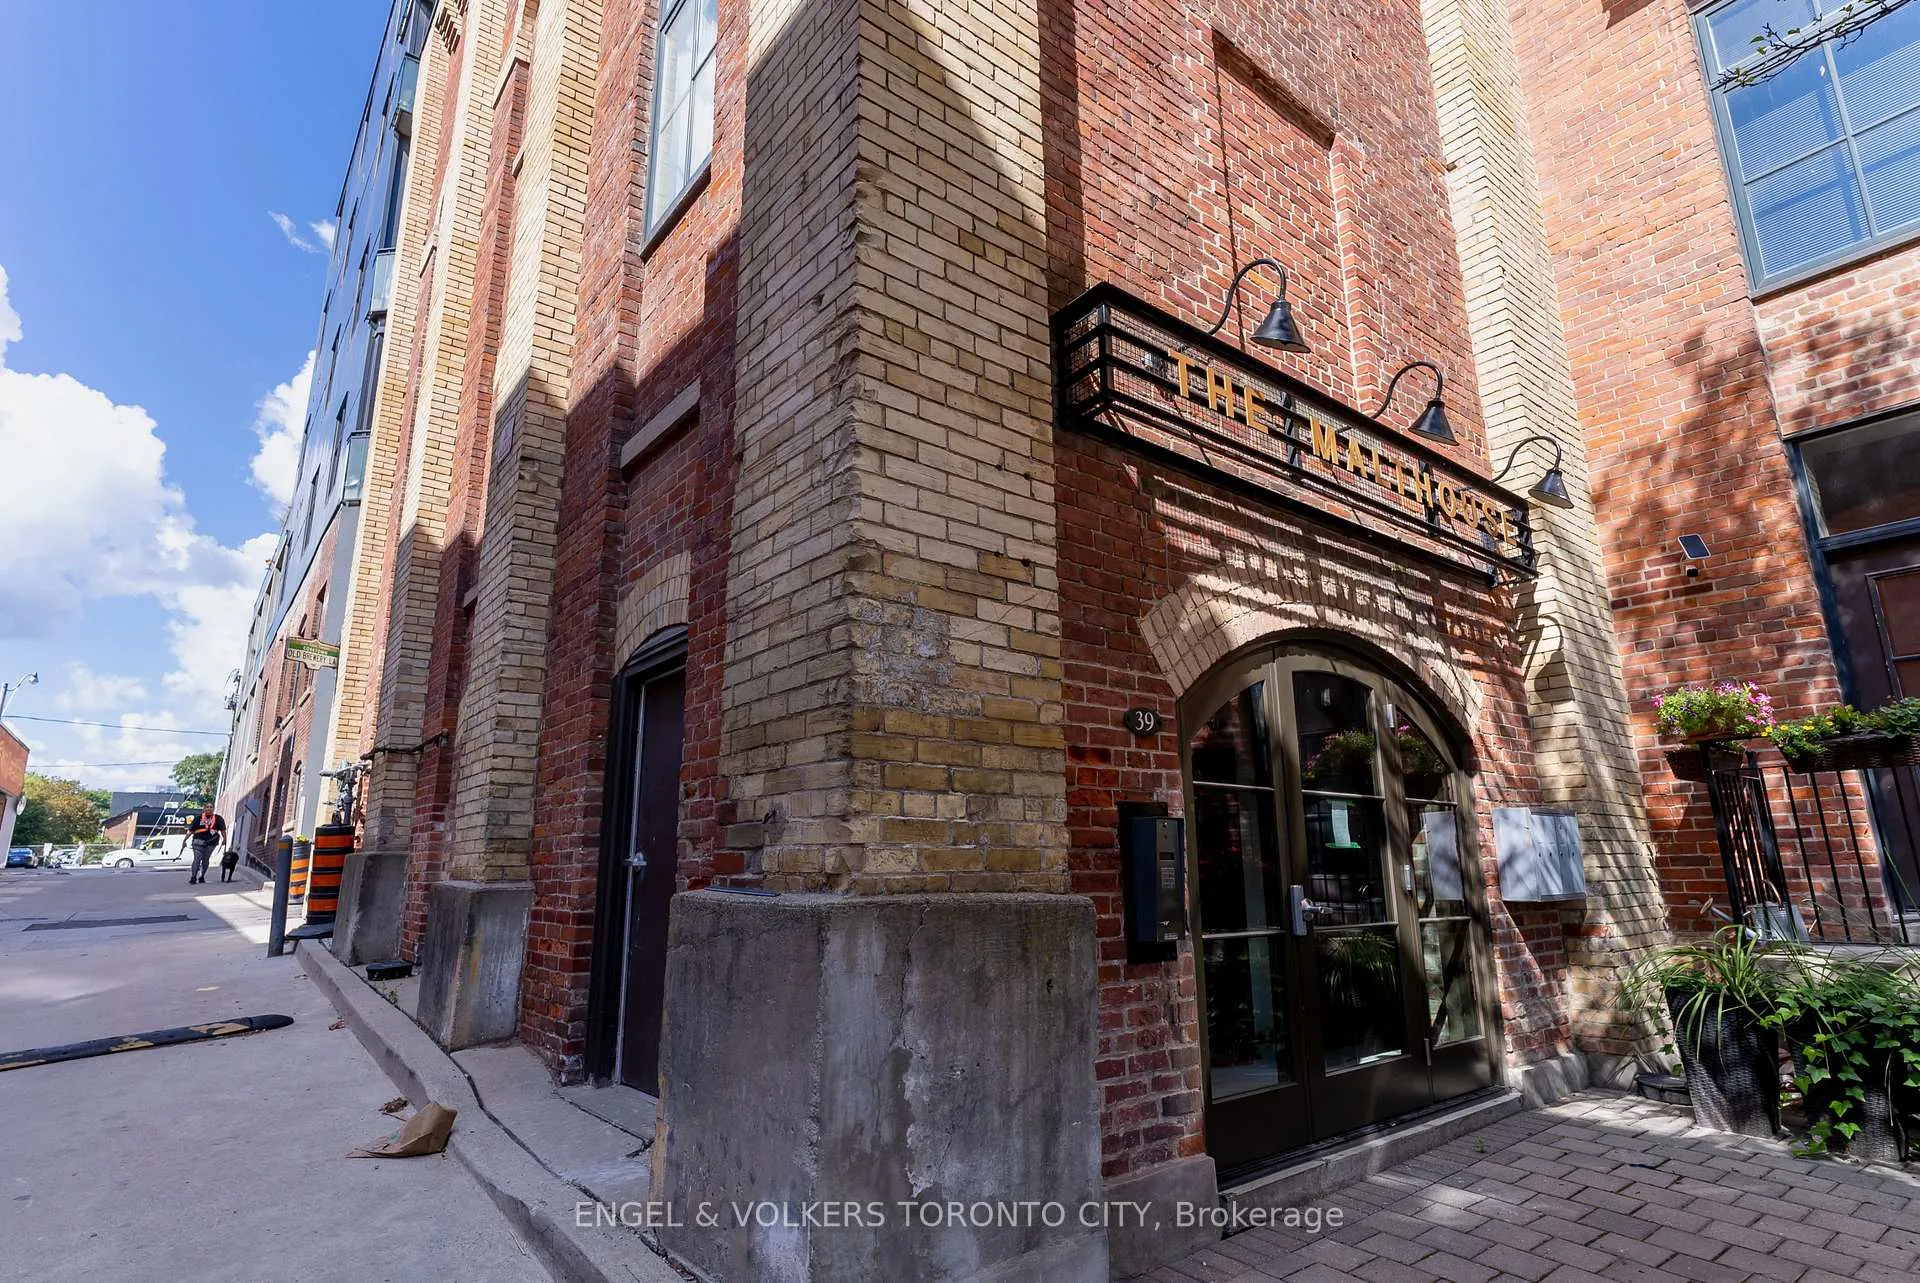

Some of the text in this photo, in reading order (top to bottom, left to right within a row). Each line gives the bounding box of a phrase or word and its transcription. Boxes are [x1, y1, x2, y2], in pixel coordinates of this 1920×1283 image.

[1168, 350, 1521, 548] THE MALTHOUSE
[287, 649, 337, 665] OLD BREWERY LA
[1135, 710, 1155, 731] 39
[164, 814, 186, 825] The
